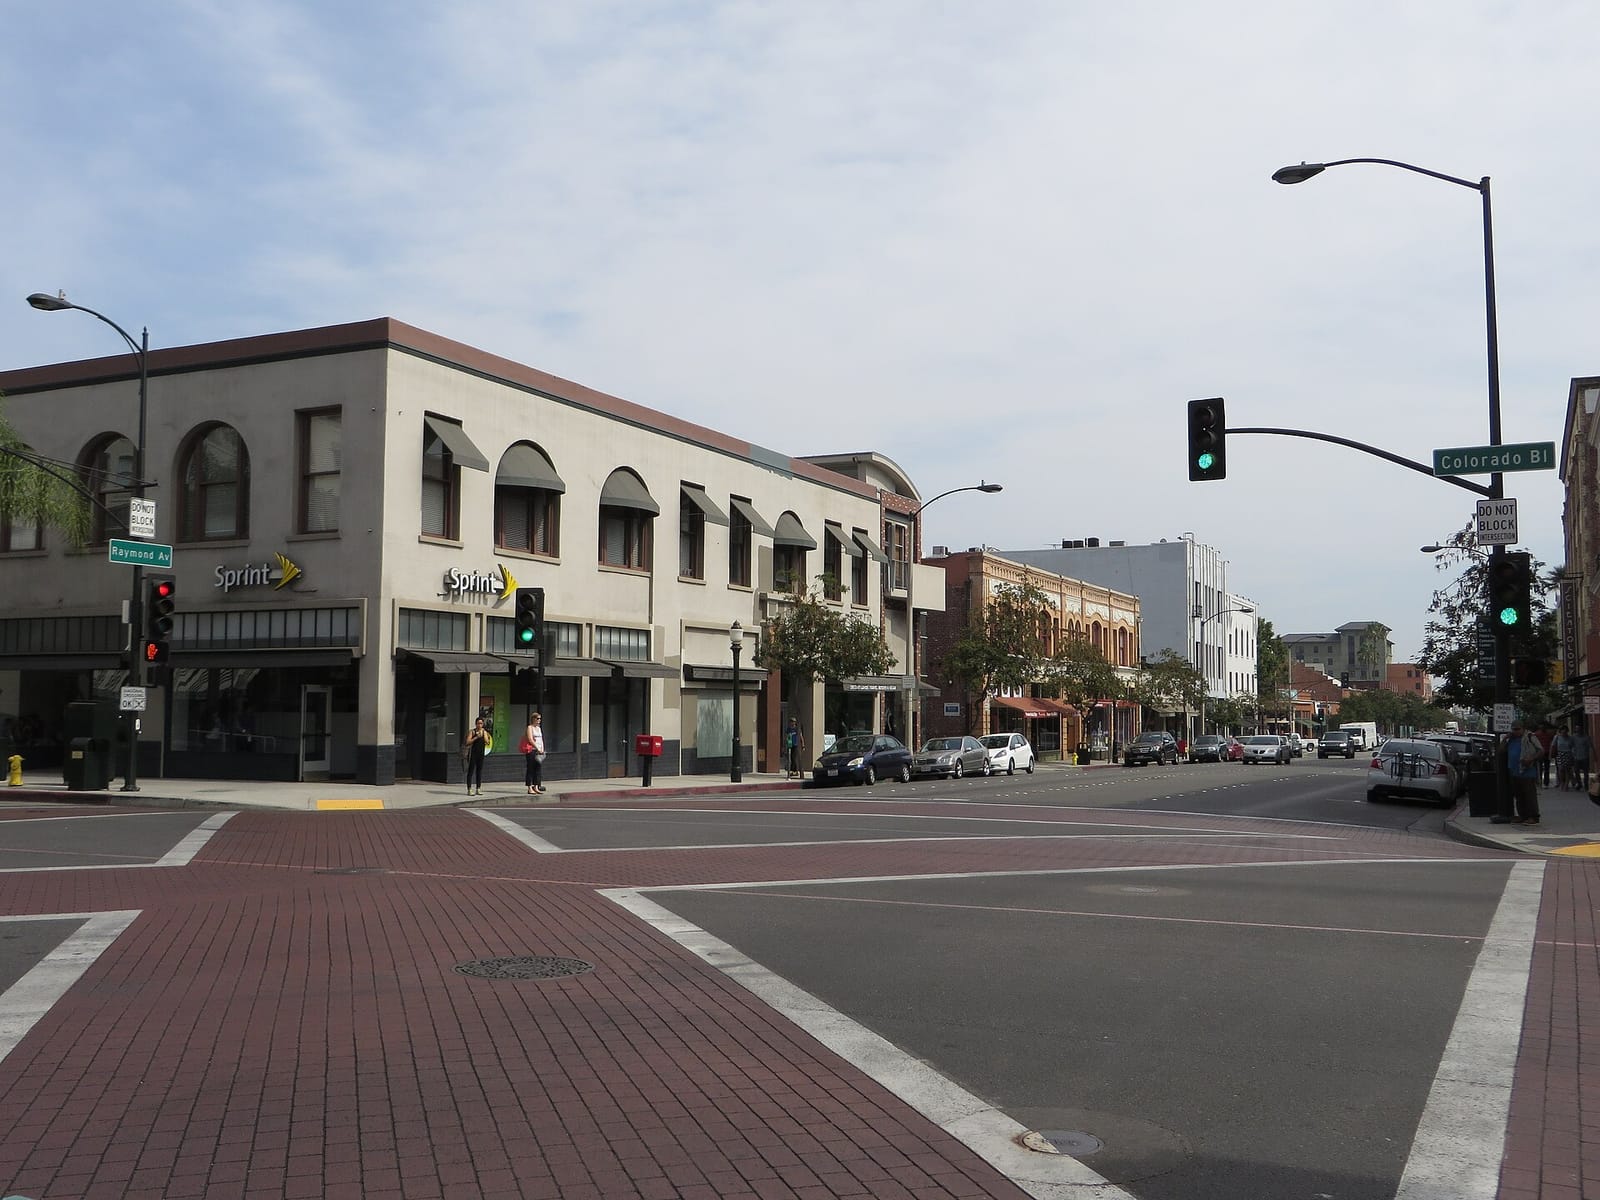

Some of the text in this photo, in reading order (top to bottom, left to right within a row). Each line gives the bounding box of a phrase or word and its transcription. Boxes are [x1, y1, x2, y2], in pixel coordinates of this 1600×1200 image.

[1441, 449, 1547, 469] Colorado Bl
[132, 503, 154, 514] DO NOT
[1479, 504, 1515, 517] DO NOT
[132, 515, 154, 526] BLOCK
[1479, 519, 1515, 531] BLOCK
[1480, 532, 1515, 541] INTERSECTION
[111, 546, 170, 561] Raymond Av
[214, 563, 270, 592] Sprint
[450, 567, 497, 596] Sprint
